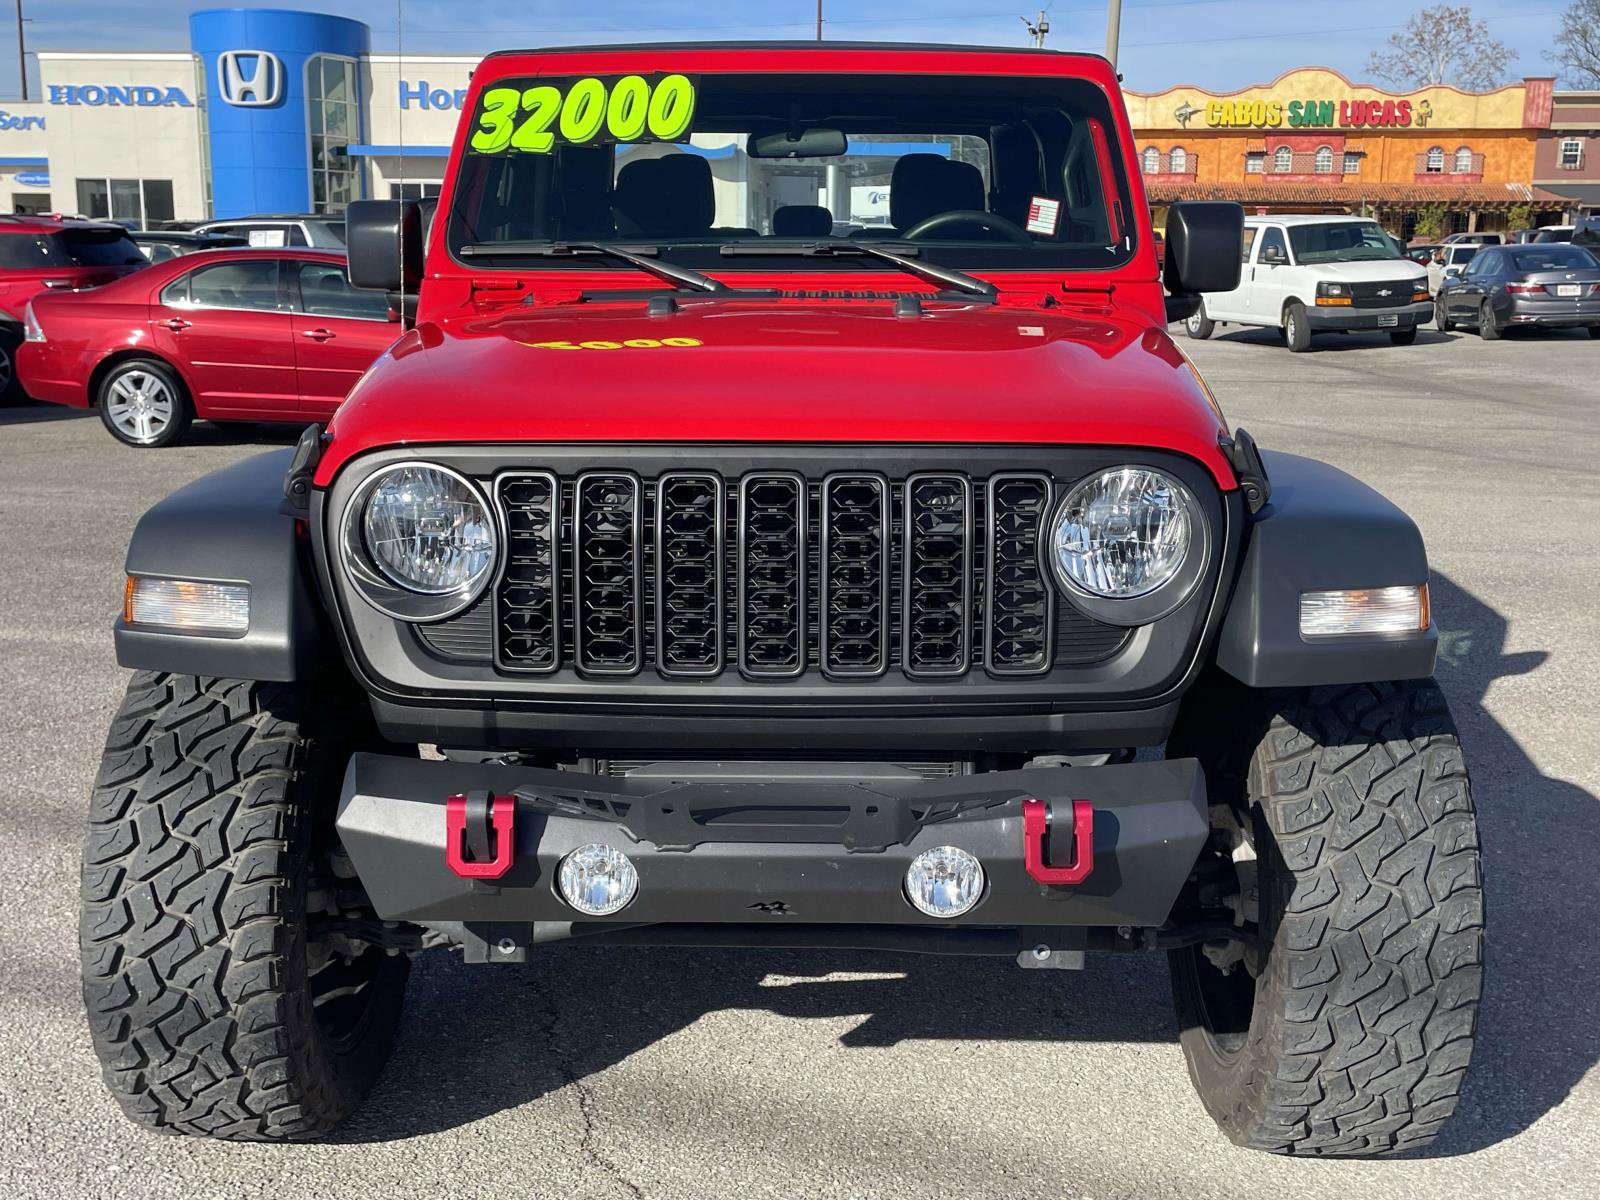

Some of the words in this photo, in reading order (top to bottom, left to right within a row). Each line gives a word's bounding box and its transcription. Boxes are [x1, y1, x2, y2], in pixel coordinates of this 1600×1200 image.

[47, 84, 195, 107] HONDA
[471, 74, 695, 153] 32000
[1205, 100, 1282, 127] CABOS
[1287, 100, 1334, 127] SAN
[1339, 100, 1412, 127] LUCAS
